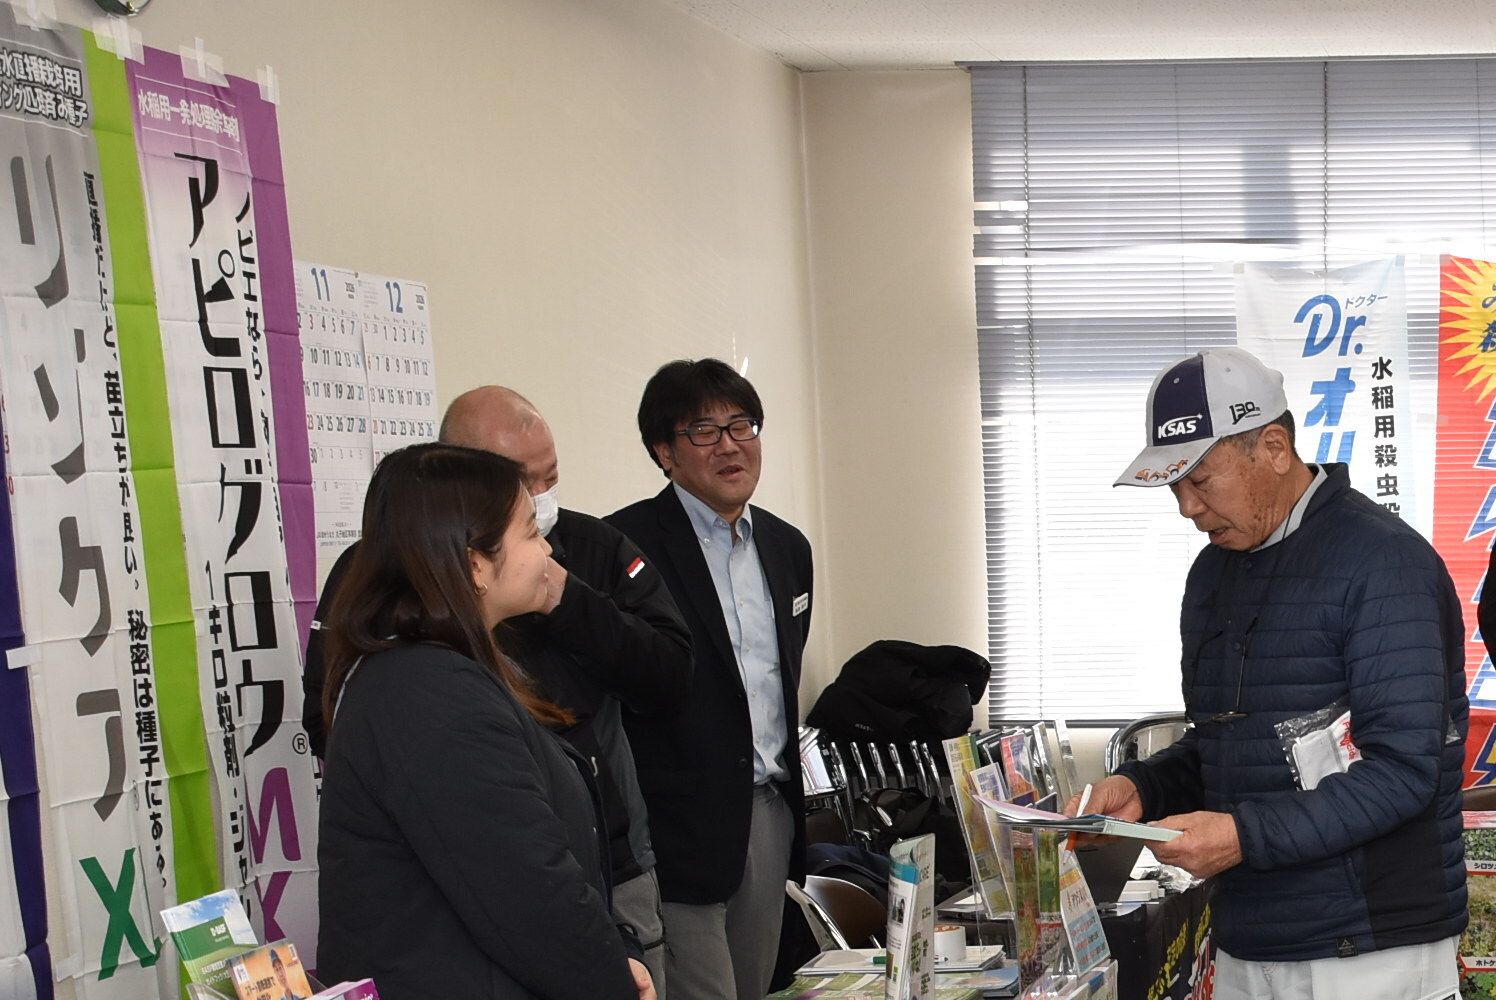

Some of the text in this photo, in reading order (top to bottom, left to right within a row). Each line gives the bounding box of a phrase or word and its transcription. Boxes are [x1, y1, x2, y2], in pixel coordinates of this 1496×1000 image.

[311, 267, 330, 301] 11
[385, 281, 403, 313] 12
[1344, 294, 1389, 310] ドクター
[322, 316, 326, 331] 4
[311, 348, 318, 364] 10
[323, 349, 330, 365] 11
[335, 351, 342, 366] 12
[344, 352, 351, 367] 13
[313, 382, 319, 397] 17
[323, 383, 330, 398] 18
[335, 384, 342, 399] 19
[347, 385, 354, 400] 20
[347, 418, 354, 432] 27
[1157, 418, 1197, 439] KSAS
